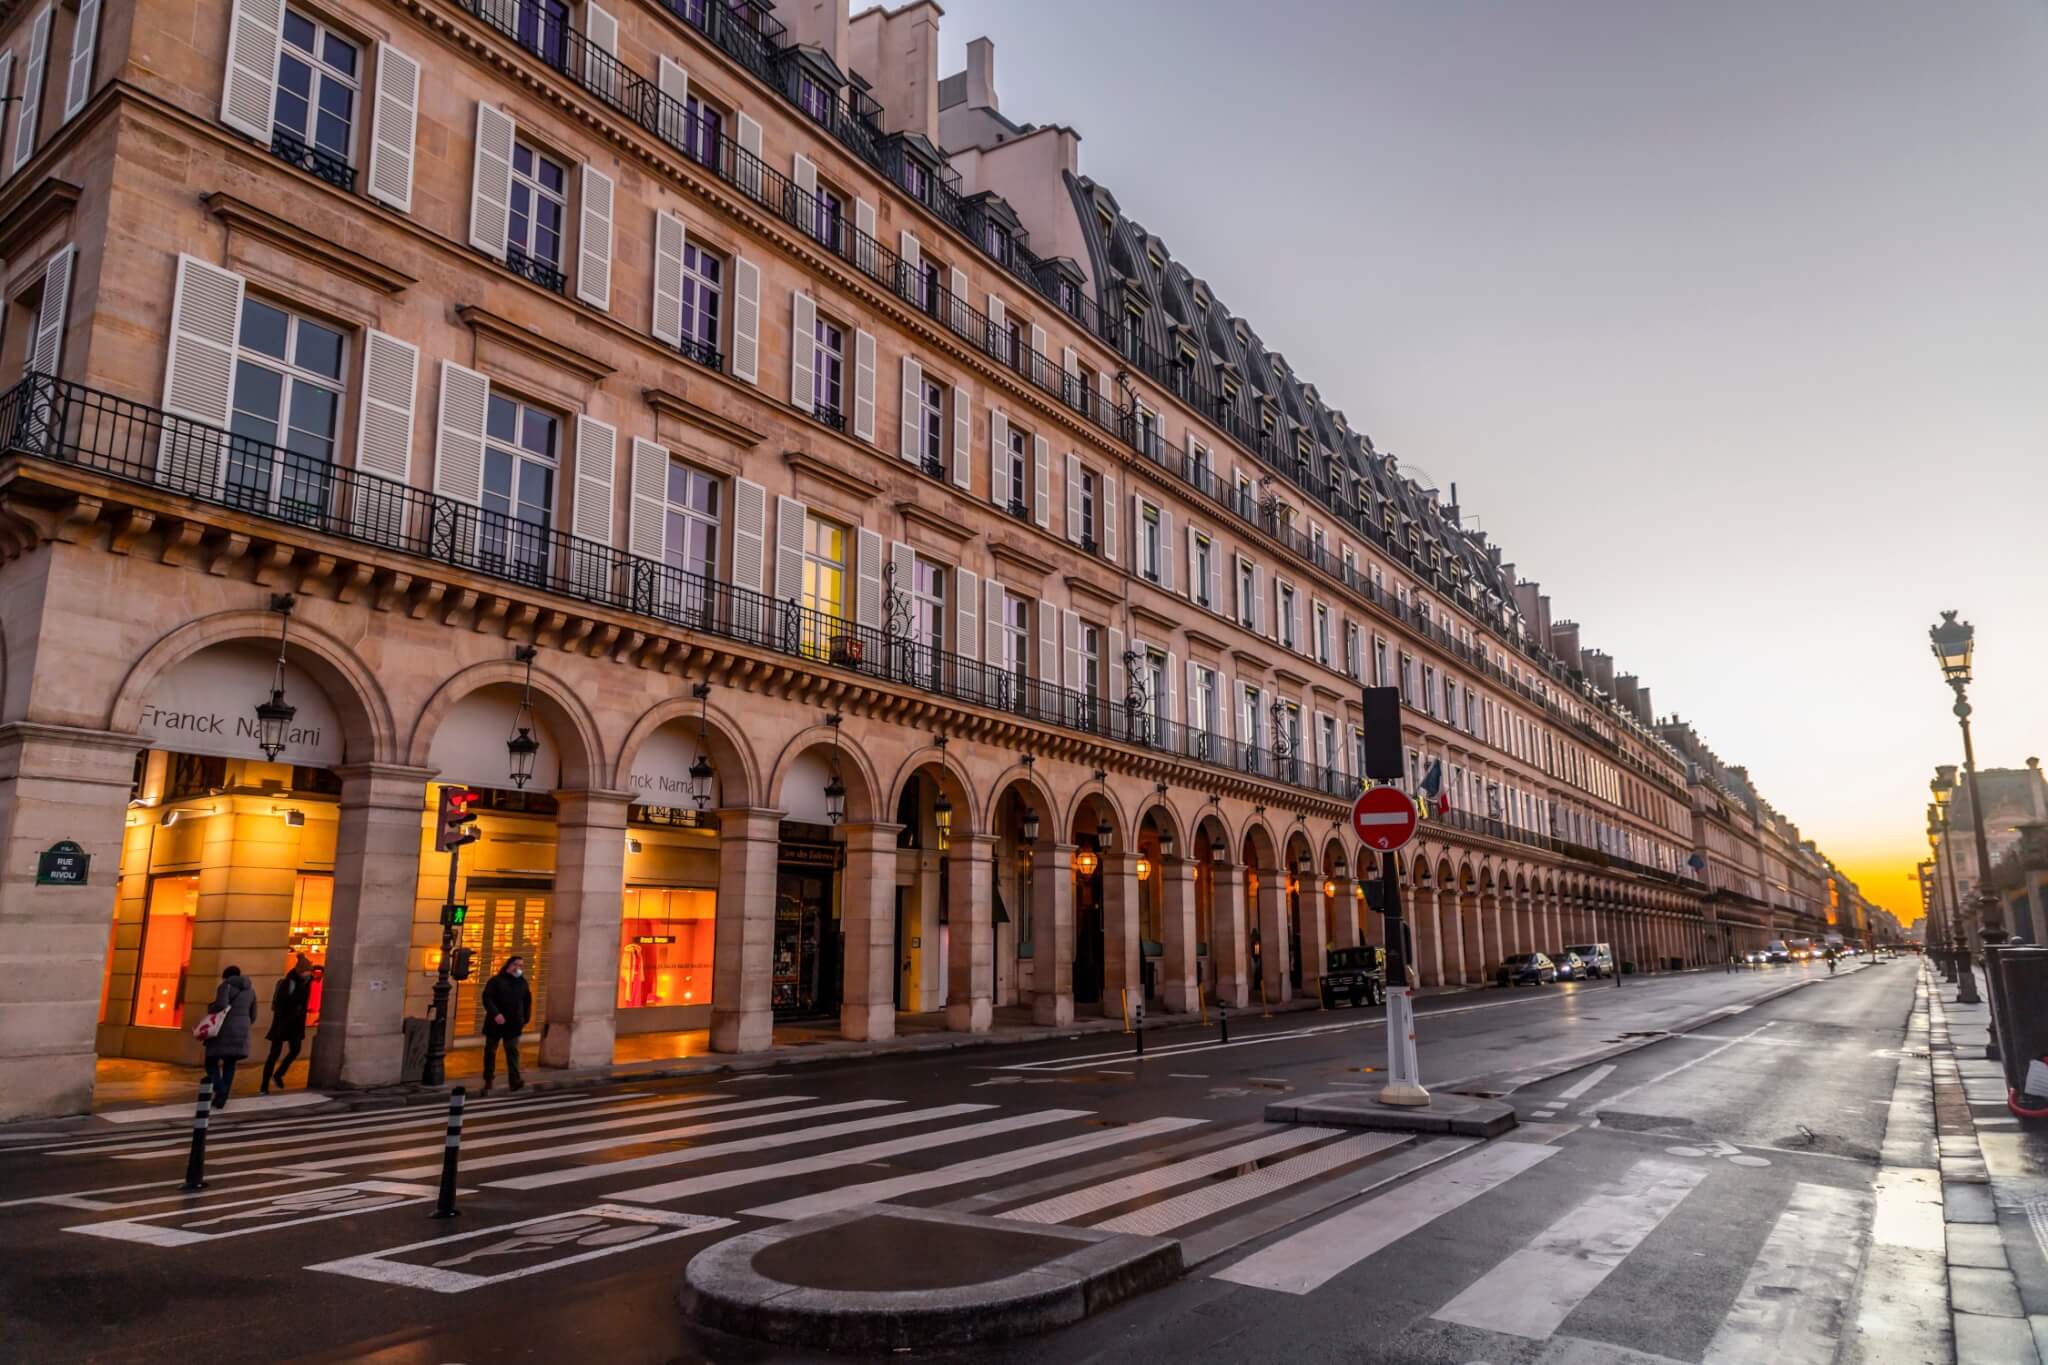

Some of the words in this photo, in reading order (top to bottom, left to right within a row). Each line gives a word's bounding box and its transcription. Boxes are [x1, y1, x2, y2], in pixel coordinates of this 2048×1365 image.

[140, 705, 225, 735] Franck
[236, 717, 320, 746] Naani
[57, 858, 73, 866] RUE
[50, 871, 77, 879] RIVOLI
